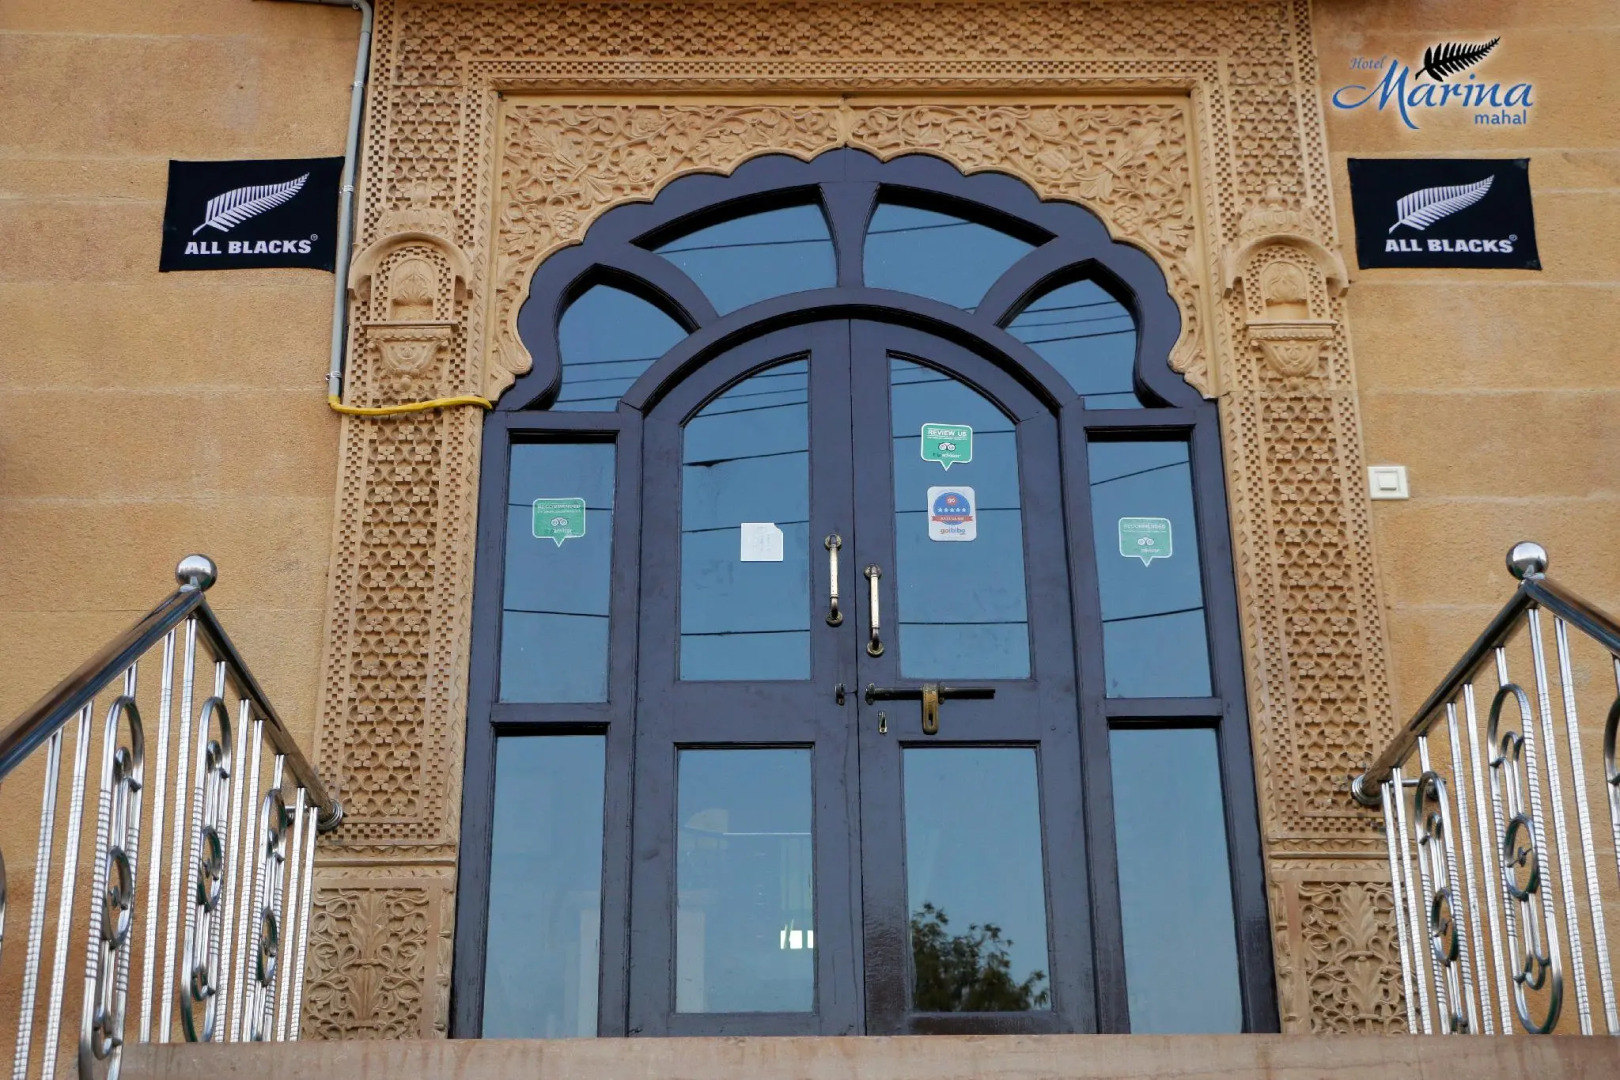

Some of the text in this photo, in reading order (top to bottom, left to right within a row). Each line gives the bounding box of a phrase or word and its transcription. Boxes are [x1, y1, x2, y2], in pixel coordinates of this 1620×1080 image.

[184, 239, 312, 255] ALL BLACKS
[1384, 239, 1514, 254] ALL BLACKS
